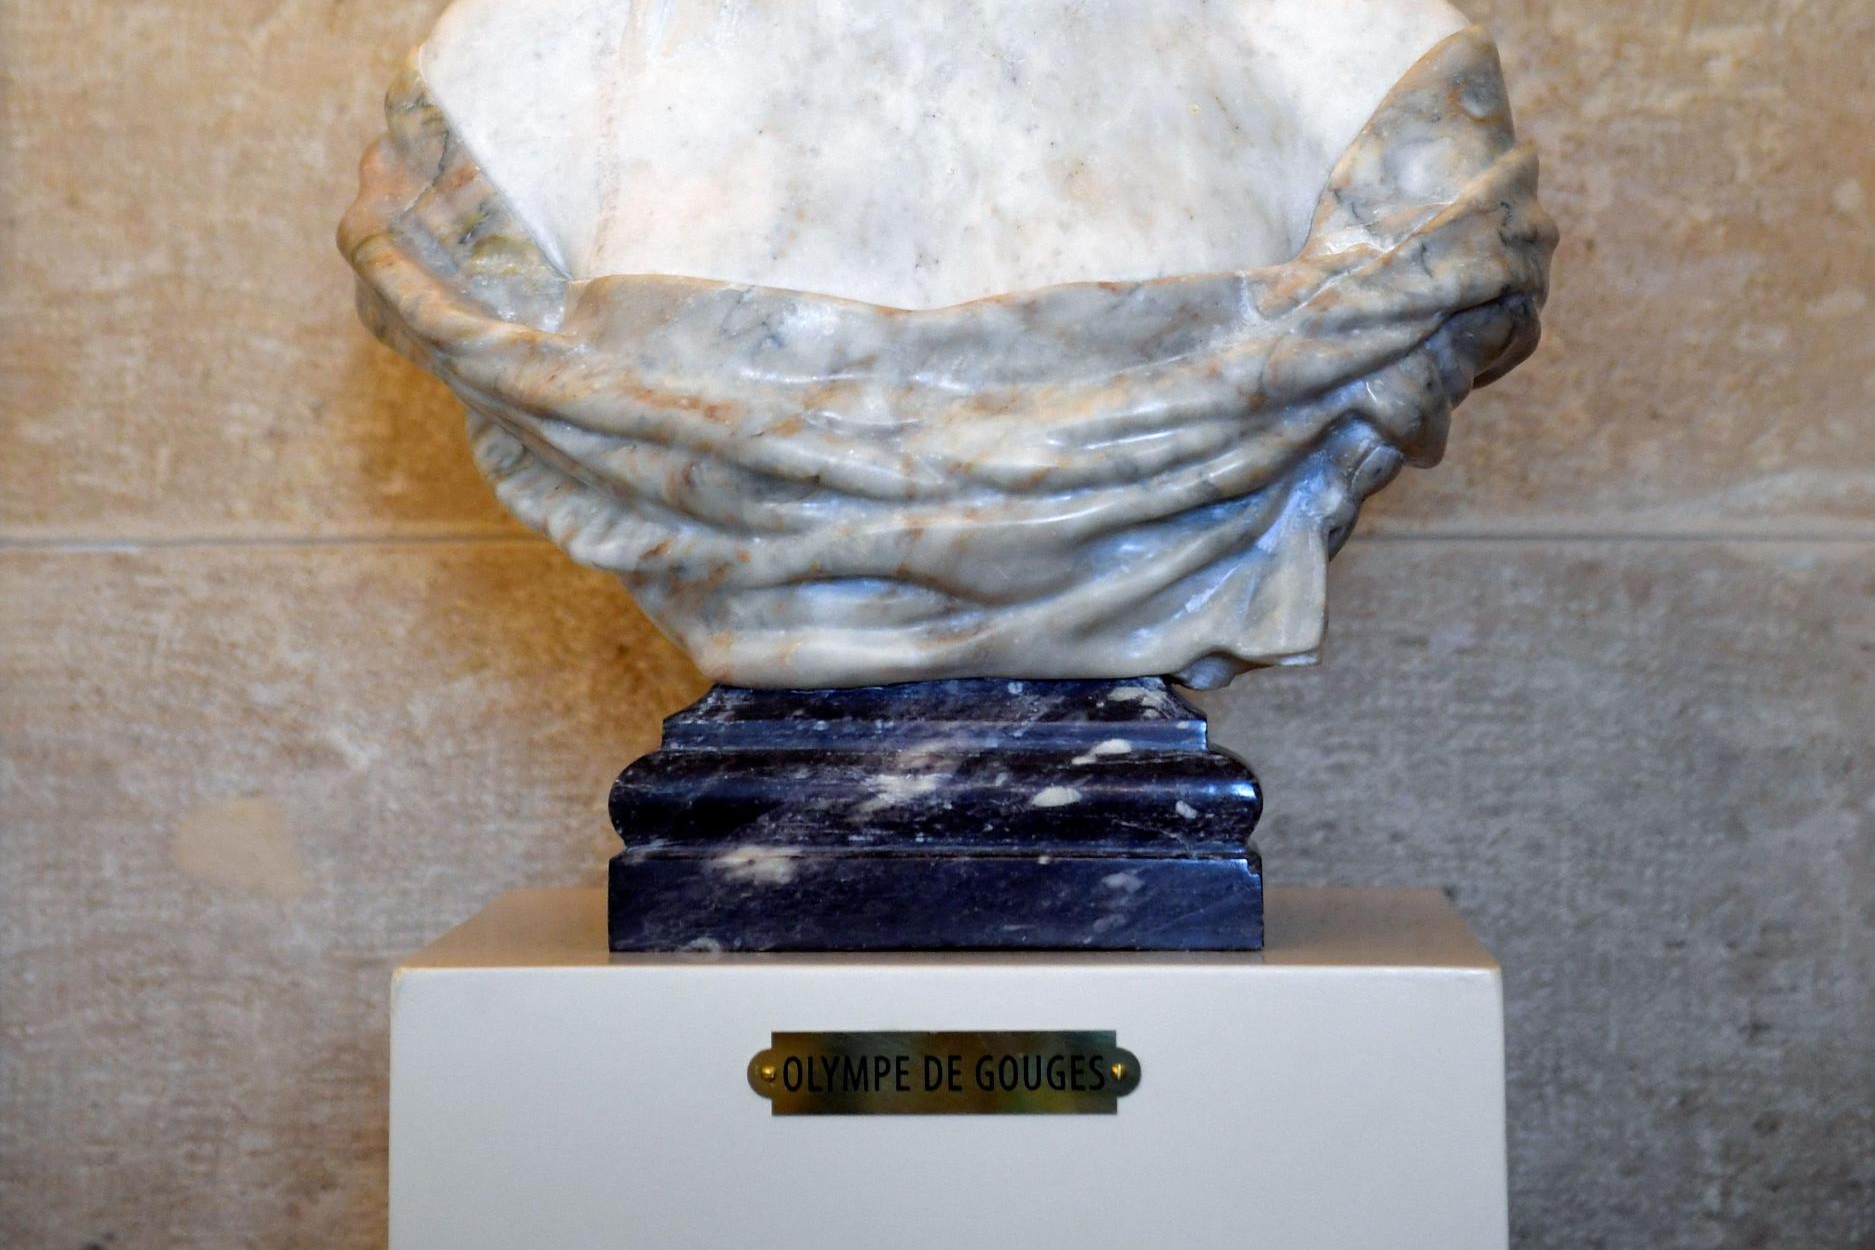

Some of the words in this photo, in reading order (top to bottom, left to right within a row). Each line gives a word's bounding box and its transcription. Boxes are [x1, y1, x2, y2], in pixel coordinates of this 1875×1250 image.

[783, 1055, 911, 1092] OLYMPE
[924, 1055, 962, 1091] DE
[975, 1054, 1105, 1091] GOUGES
